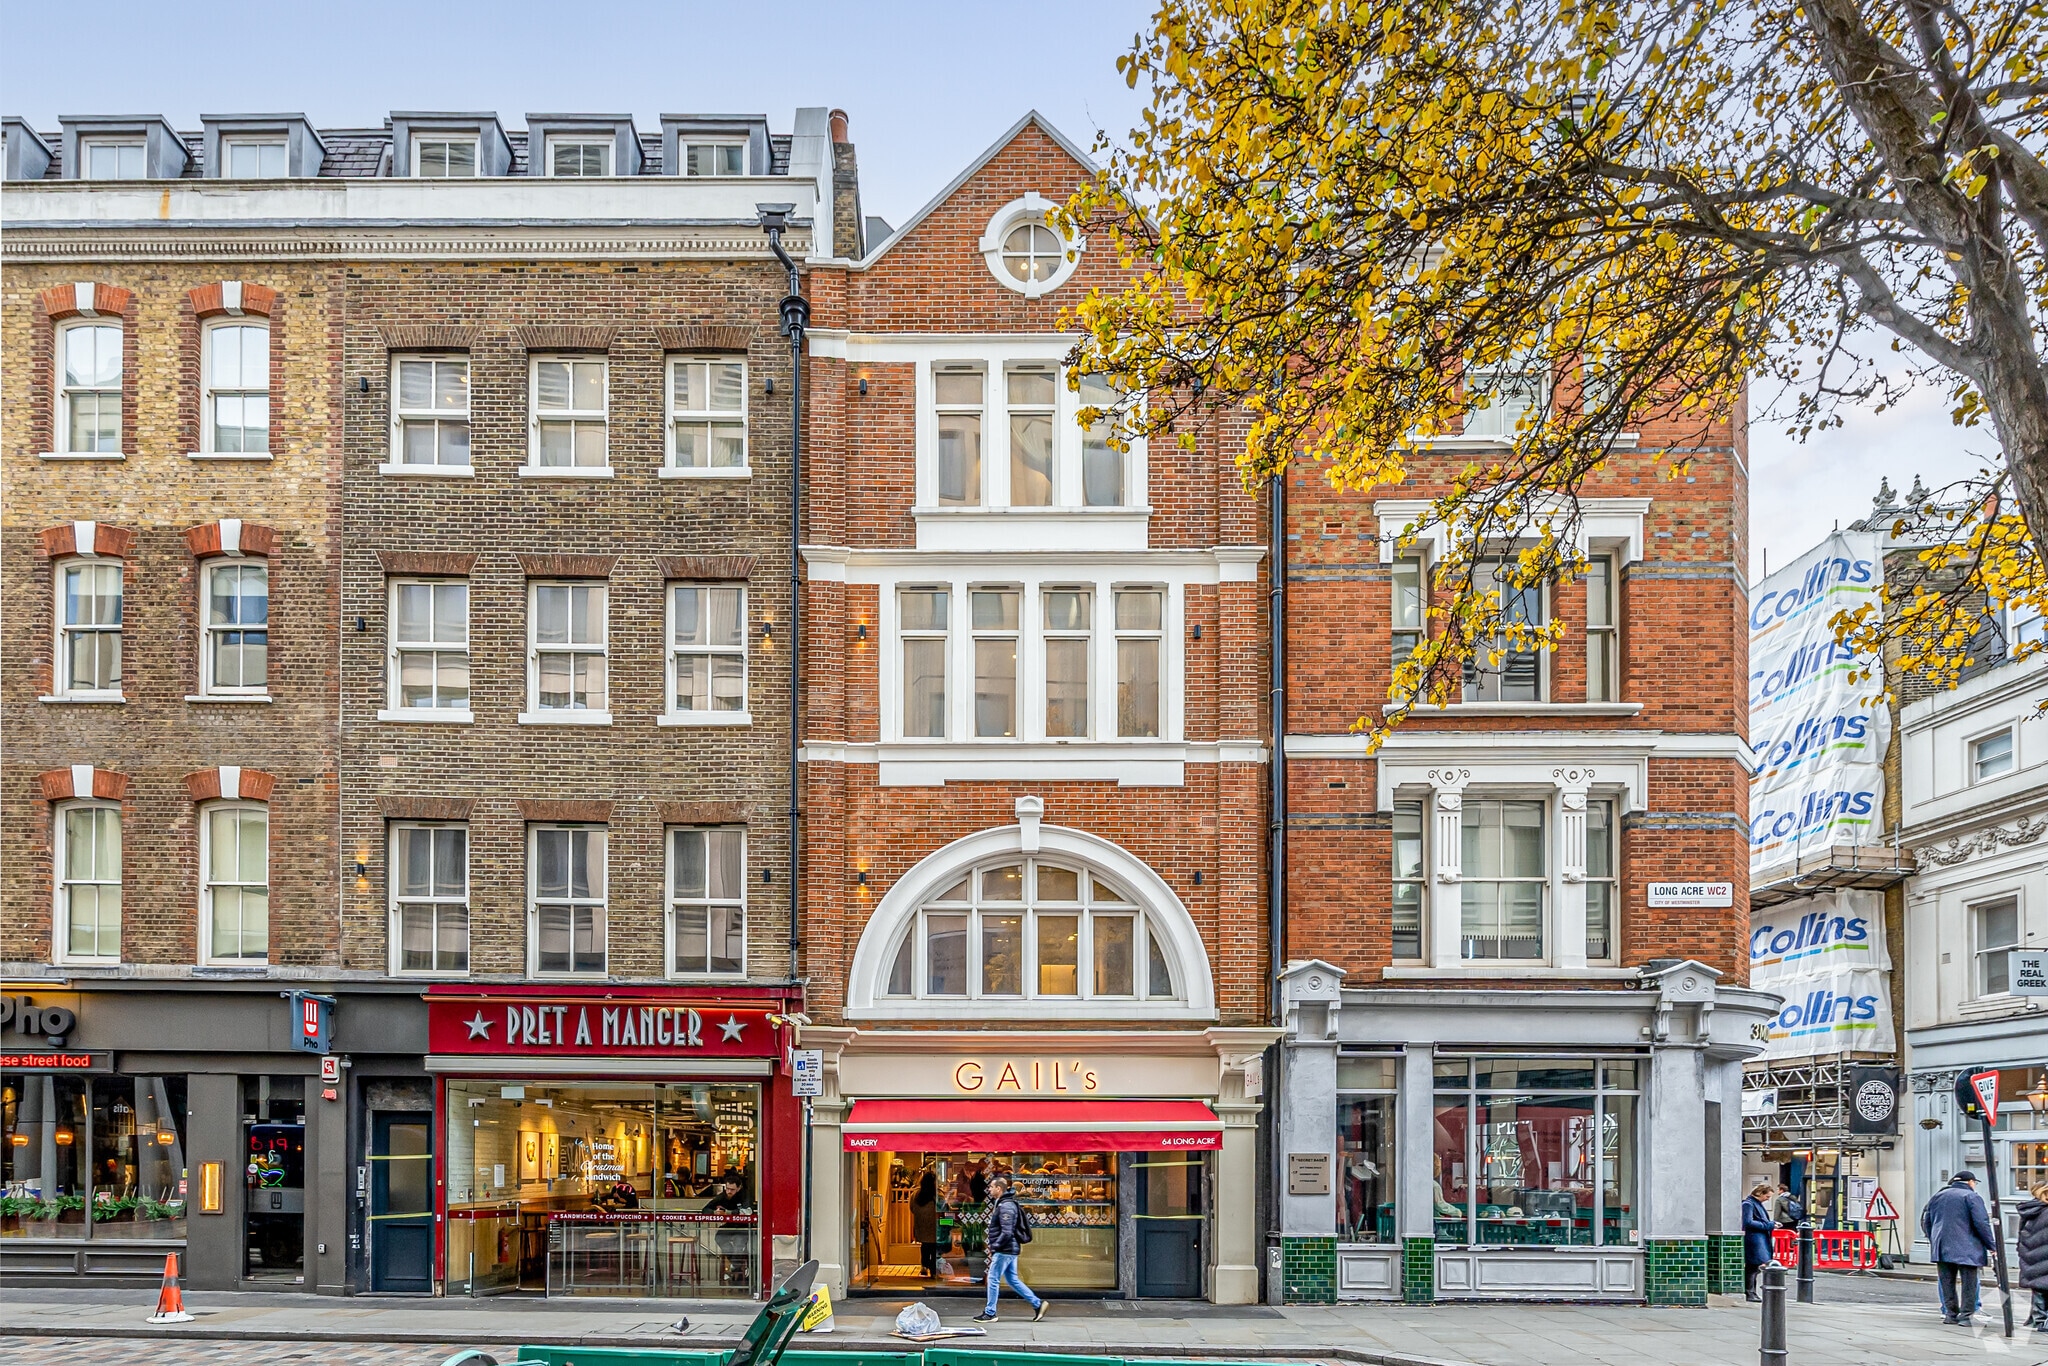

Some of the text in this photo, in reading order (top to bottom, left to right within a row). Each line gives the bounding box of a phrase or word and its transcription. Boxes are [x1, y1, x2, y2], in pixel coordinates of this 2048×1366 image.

[1750, 556, 1873, 630] Collins
[1753, 715, 1869, 773] Collins
[1749, 789, 1874, 845] Collins
[1654, 886, 1727, 896] LONG ACRE WC2
[1750, 912, 1868, 959] Collins
[2021, 960, 2040, 968] THE
[2020, 969, 2044, 978] REAL
[2016, 979, 2047, 988] GREEK
[1767, 990, 1878, 1029] ollins
[507, 1005, 704, 1047] PRET A MANGER
[304, 1037, 319, 1049] Pho
[21, 1054, 58, 1067] street
[61, 1054, 90, 1067] food
[955, 1061, 1098, 1091] GAIL's
[1978, 1079, 1995, 1093] GIVE
[850, 1139, 878, 1147] BAKERY
[1162, 1137, 1216, 1146] 64 LONG ACRE
[593, 1152, 615, 1160] of the
[585, 1173, 621, 1181] sandwich
